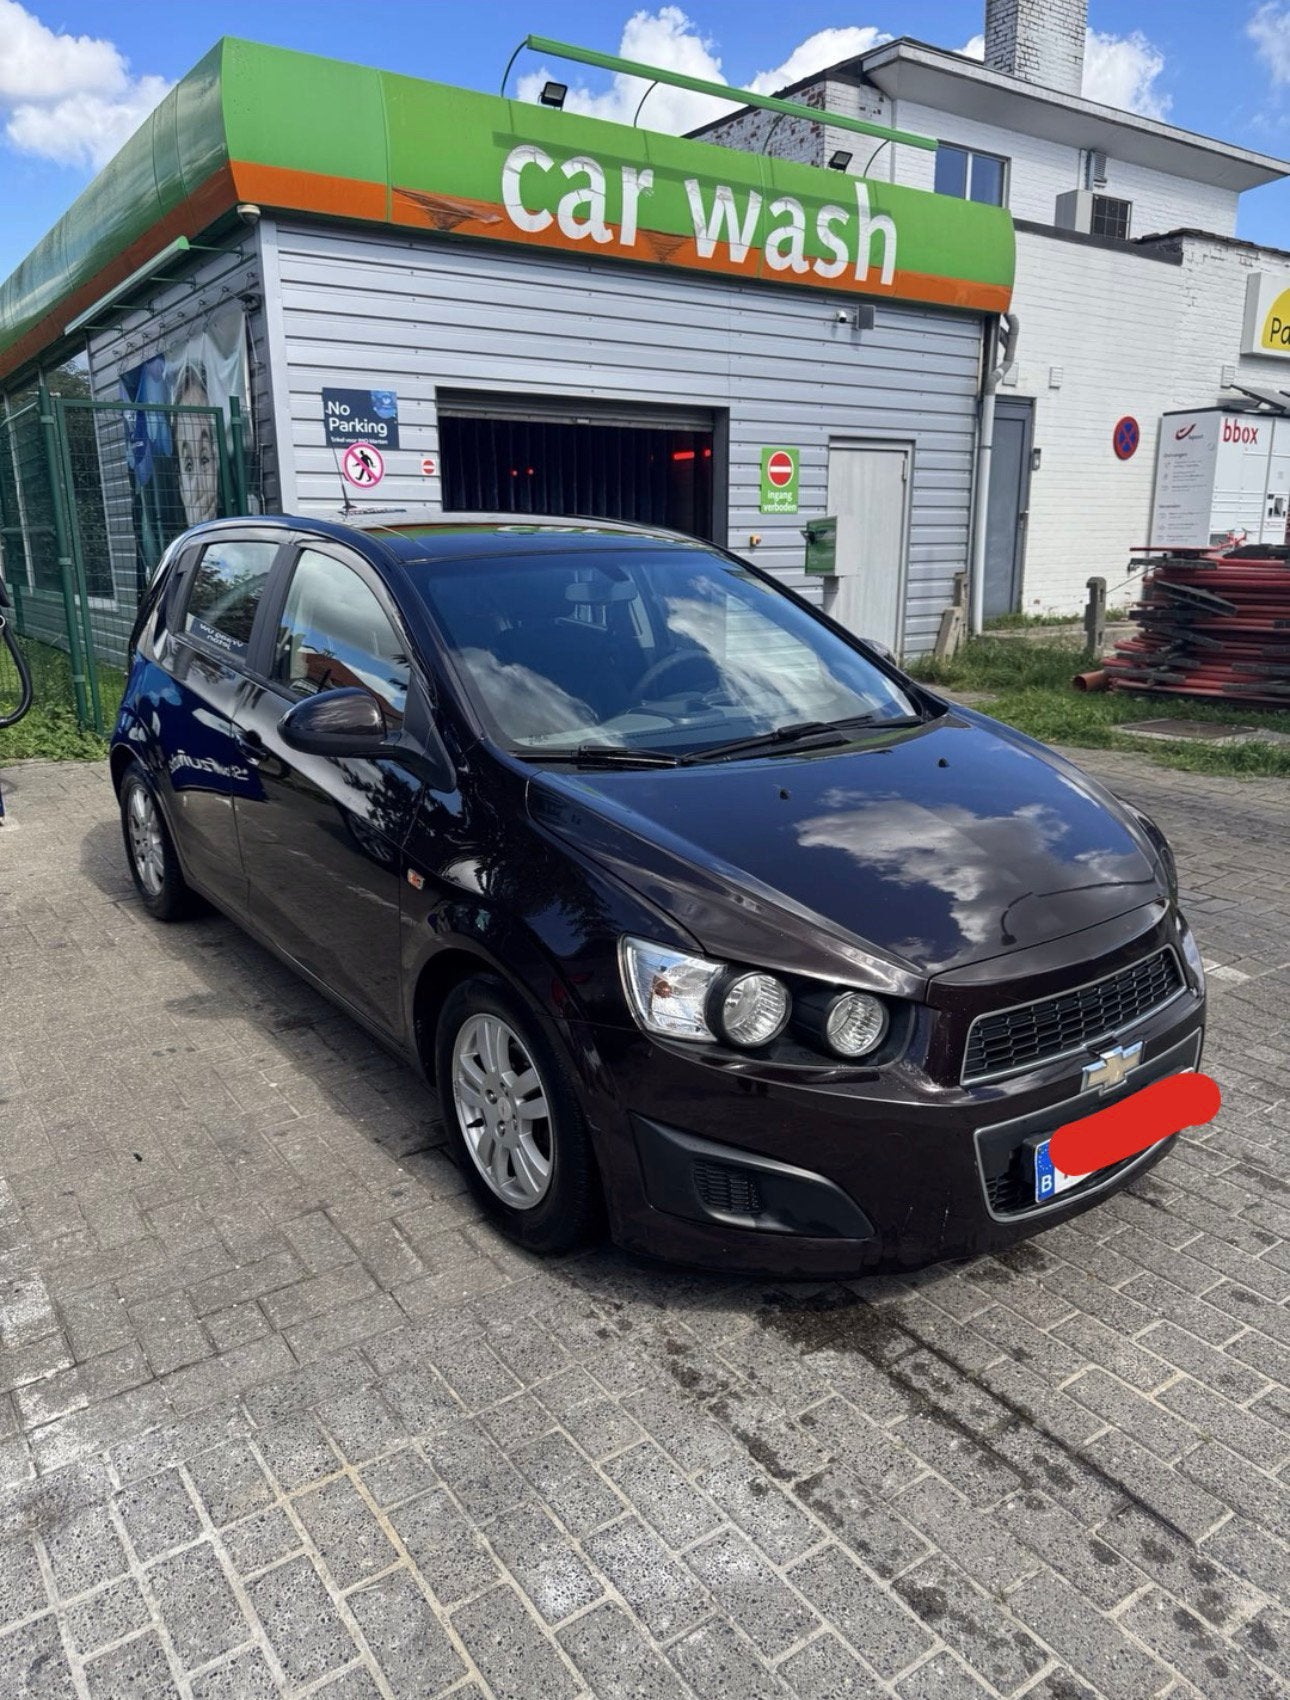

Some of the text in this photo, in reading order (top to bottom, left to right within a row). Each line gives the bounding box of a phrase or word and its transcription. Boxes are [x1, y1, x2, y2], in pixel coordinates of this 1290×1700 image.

[502, 144, 898, 286] car wash
[326, 401, 351, 416] No
[328, 417, 388, 438] Parking
[1222, 417, 1259, 444] bbox
[767, 490, 793, 502] ingang
[763, 502, 798, 512] verboden
[1041, 1174, 1053, 1194] B
